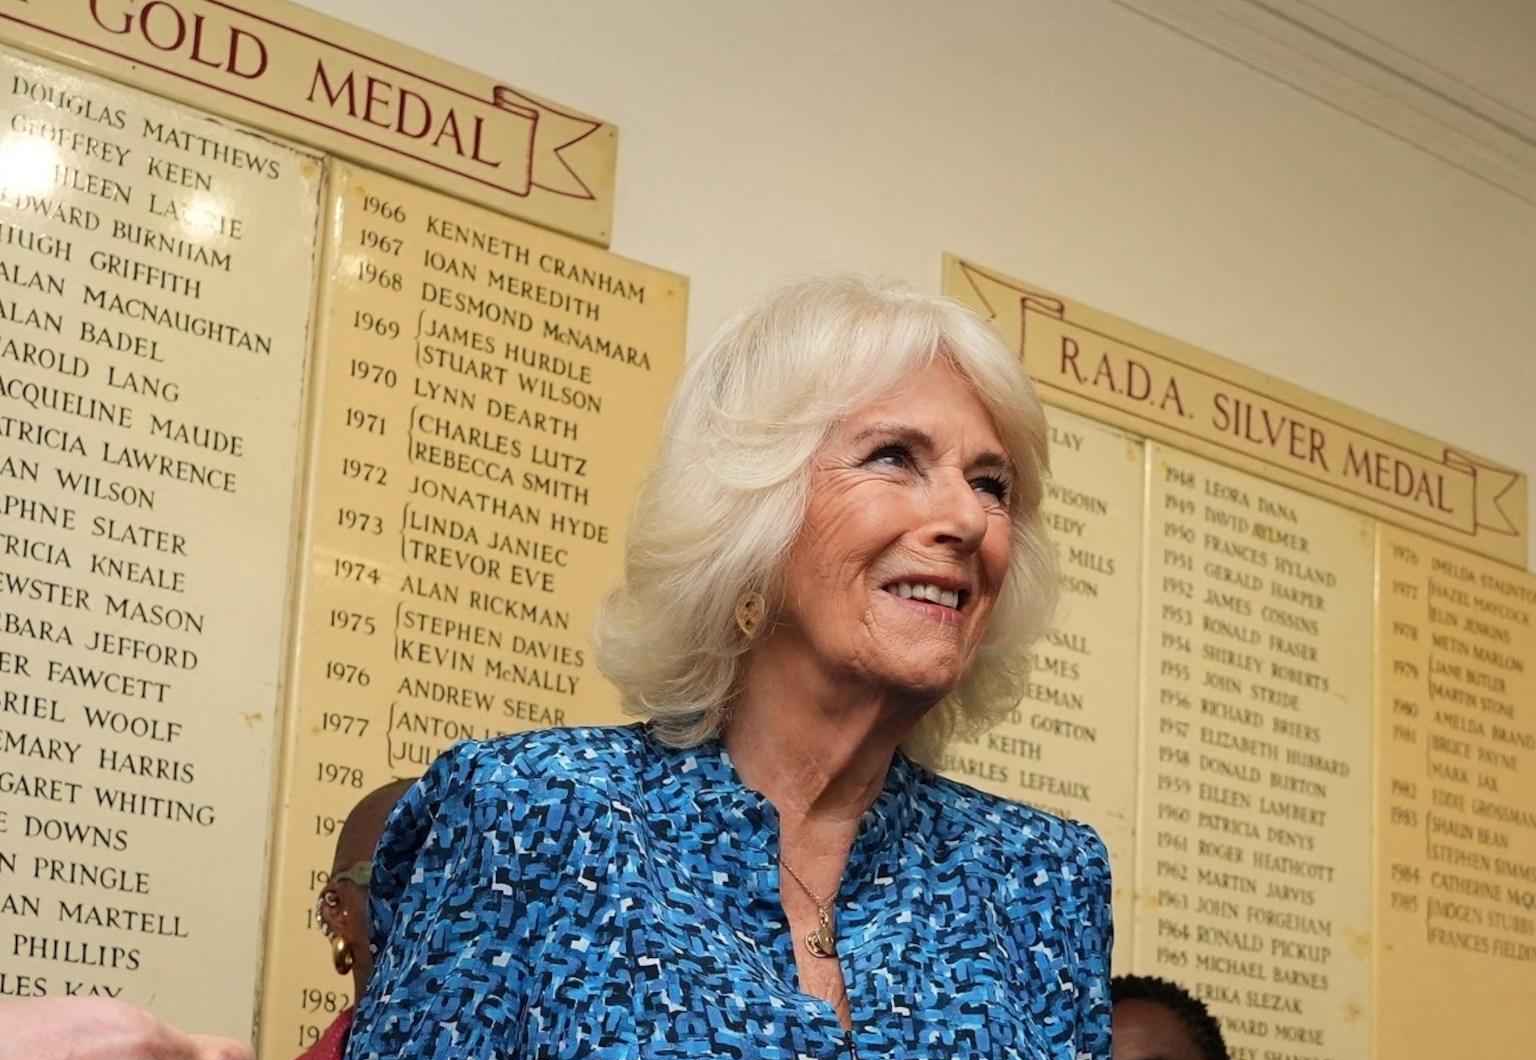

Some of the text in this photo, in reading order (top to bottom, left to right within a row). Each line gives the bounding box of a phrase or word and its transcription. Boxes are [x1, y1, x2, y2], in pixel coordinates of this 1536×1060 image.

[90, 0, 500, 167] GOLD MEDAL
[12, 76, 280, 180] DOUGLAS MATTHEWS
[147, 156, 213, 193] KEEN
[0, 223, 201, 299] HUGH GRIFFITH
[14, 193, 231, 271] DWARD BURNHAM
[364, 196, 645, 303] 1966 KENNETH CRANHAM
[360, 230, 600, 321] 1967 IOAN MEREDITH
[80, 321, 164, 362] BADEL
[83, 284, 272, 354] MACNAUGHTAN
[358, 262, 650, 370] 1968 DESMOND McNAMARA
[0, 336, 179, 403] AROLD LANG
[353, 311, 592, 384] 1969 JAMES HURDLE
[351, 359, 578, 440] 1970 LYNN DEARTH
[423, 346, 601, 413] STUART WILSON
[0, 374, 243, 457] CQUELINE MAUDE
[346, 408, 587, 476] 1971 CHARLES LUTZ
[1061, 336, 1454, 513] R.A.D.A. SILVER MEDAL
[0, 416, 236, 492] TRICIA LAWRENCE
[415, 442, 588, 505] REBECCA SMITH
[55, 467, 155, 509] WILSON
[342, 458, 609, 544] 1972 JONATHAN HYDE
[0, 494, 187, 556] PHNE SLATER
[338, 509, 568, 567] 1973 LINDA JANIEC
[0, 533, 185, 592] RICIA KNEALE
[410, 539, 554, 592] TREVOR EVE
[0, 571, 205, 634] WSTER MASON
[334, 559, 569, 629] 1974 ALAN RICKMAN
[0, 613, 198, 670] BARA JEFFORD
[330, 610, 584, 667] 1975 STEPHEN DAVIES
[400, 640, 579, 695] KEVIN McNALLY
[47, 661, 171, 703] FAWCETT
[326, 661, 565, 725] 1976 ANDREW SEEAR
[0, 690, 182, 743] RIEL WOOLF
[322, 713, 369, 737] 1977
[396, 712, 474, 739] ANTON
[0, 730, 194, 783] MARY HARRIS
[318, 763, 364, 788] 1978
[0, 772, 215, 827] GARET WHITING
[25, 815, 128, 851] DOWNS
[34, 857, 150, 894] PRINGLE
[59, 901, 188, 938] MARTELL
[13, 933, 140, 970] PHILLIPS
[302, 988, 349, 1014] 1982
